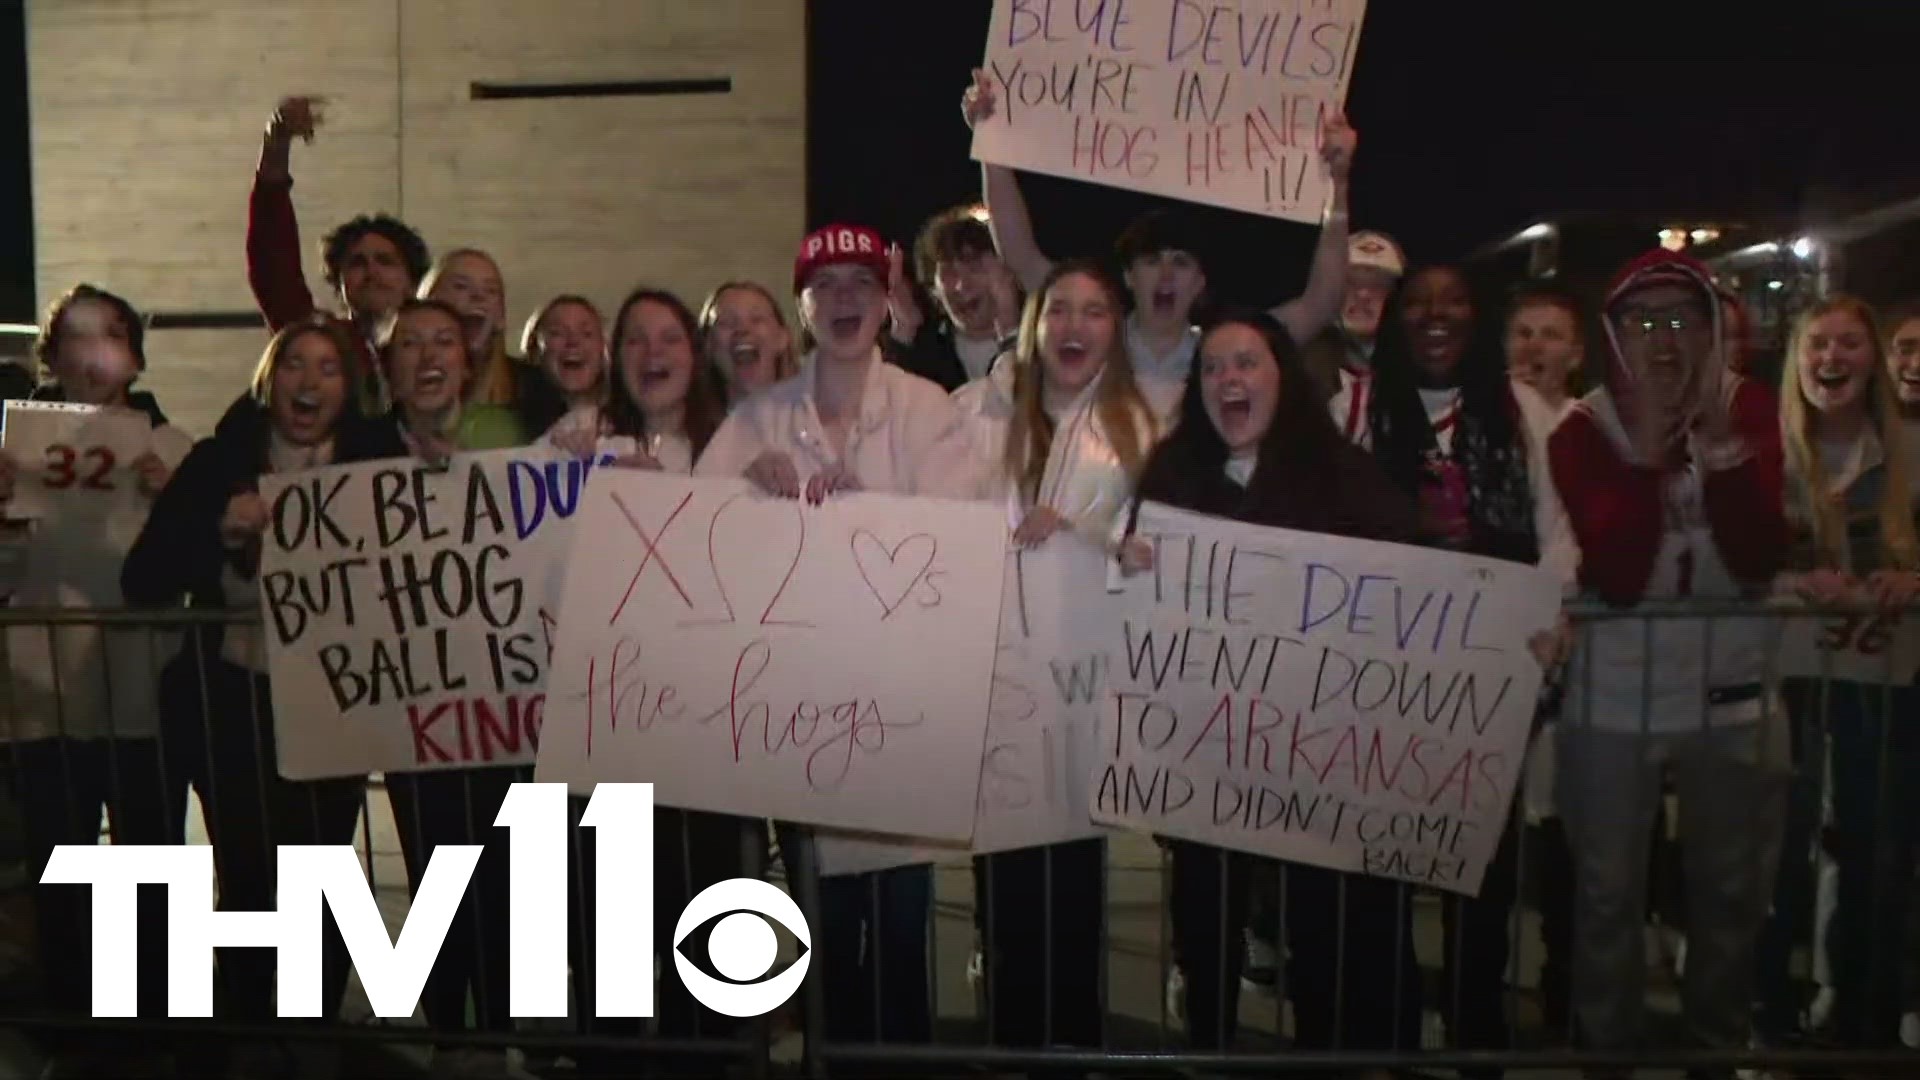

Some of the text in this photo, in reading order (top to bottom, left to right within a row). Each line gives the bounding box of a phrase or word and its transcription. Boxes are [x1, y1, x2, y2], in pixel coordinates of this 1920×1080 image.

[1009, 0, 1356, 88] BLUE DEVILS!
[991, 54, 1231, 127] YOU'RE IN
[1072, 115, 1159, 179] HOG
[43, 445, 115, 489] 32
[271, 473, 366, 552] OK,
[372, 461, 450, 548] BE
[462, 461, 504, 546] A
[262, 543, 524, 647] BUT HOG
[1143, 533, 1505, 656] THE DEVIL
[318, 628, 467, 713] BALL
[486, 632, 540, 693] IS
[568, 635, 687, 762] the
[700, 639, 923, 793] hogs
[1123, 619, 1513, 737] WENT DOWN
[1113, 691, 1179, 760] TO
[1182, 692, 1508, 812] ARKANSAS
[1097, 763, 1195, 816] AND
[1212, 775, 1358, 846] DIDN'T
[1357, 809, 1480, 853] COME
